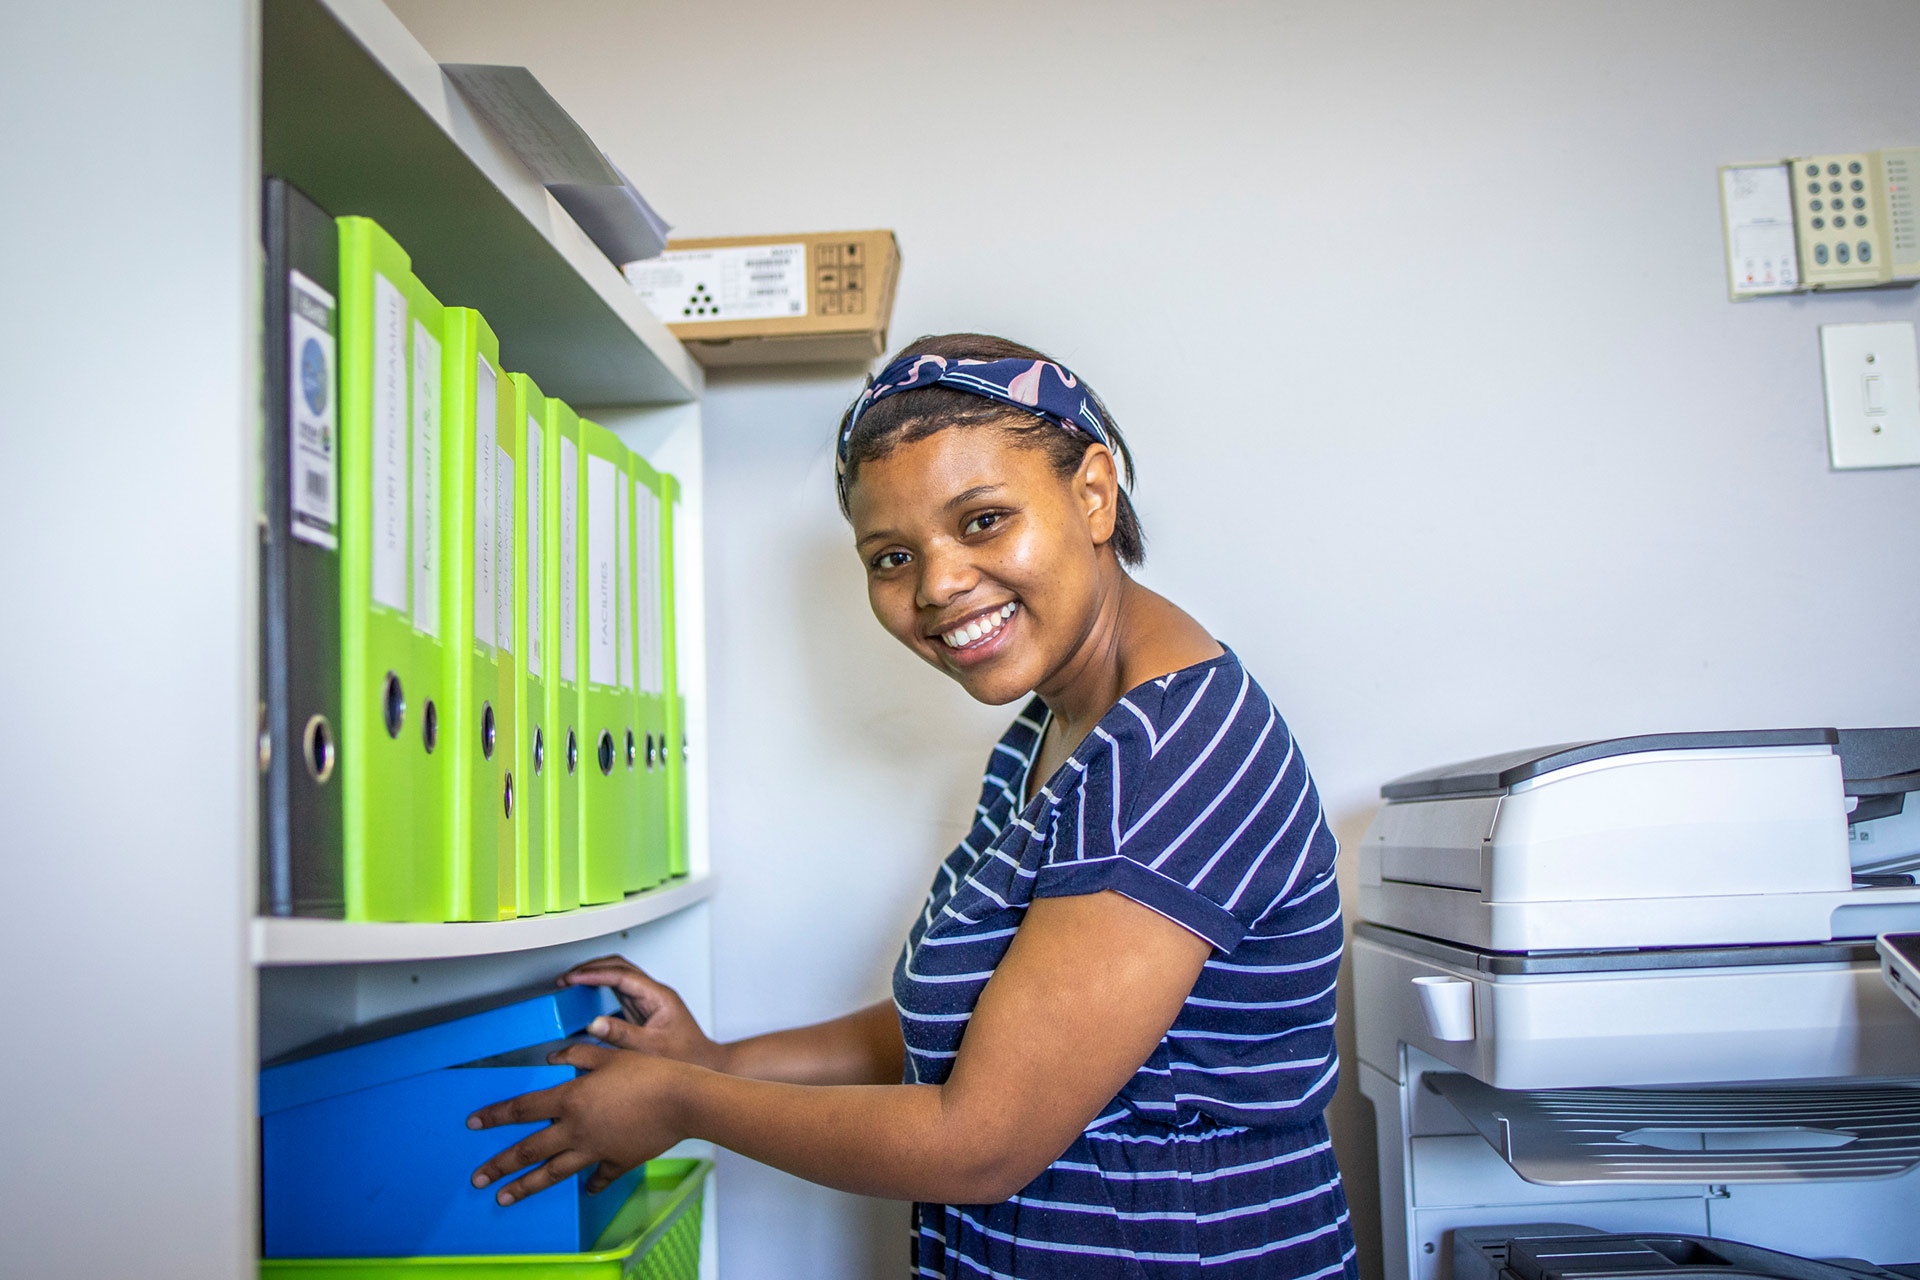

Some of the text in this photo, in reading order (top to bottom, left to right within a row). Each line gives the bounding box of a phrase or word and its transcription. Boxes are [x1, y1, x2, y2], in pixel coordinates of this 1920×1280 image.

[386, 295, 397, 550] SPORT PROGRAMME
[601, 560, 609, 647] FACILITIES
